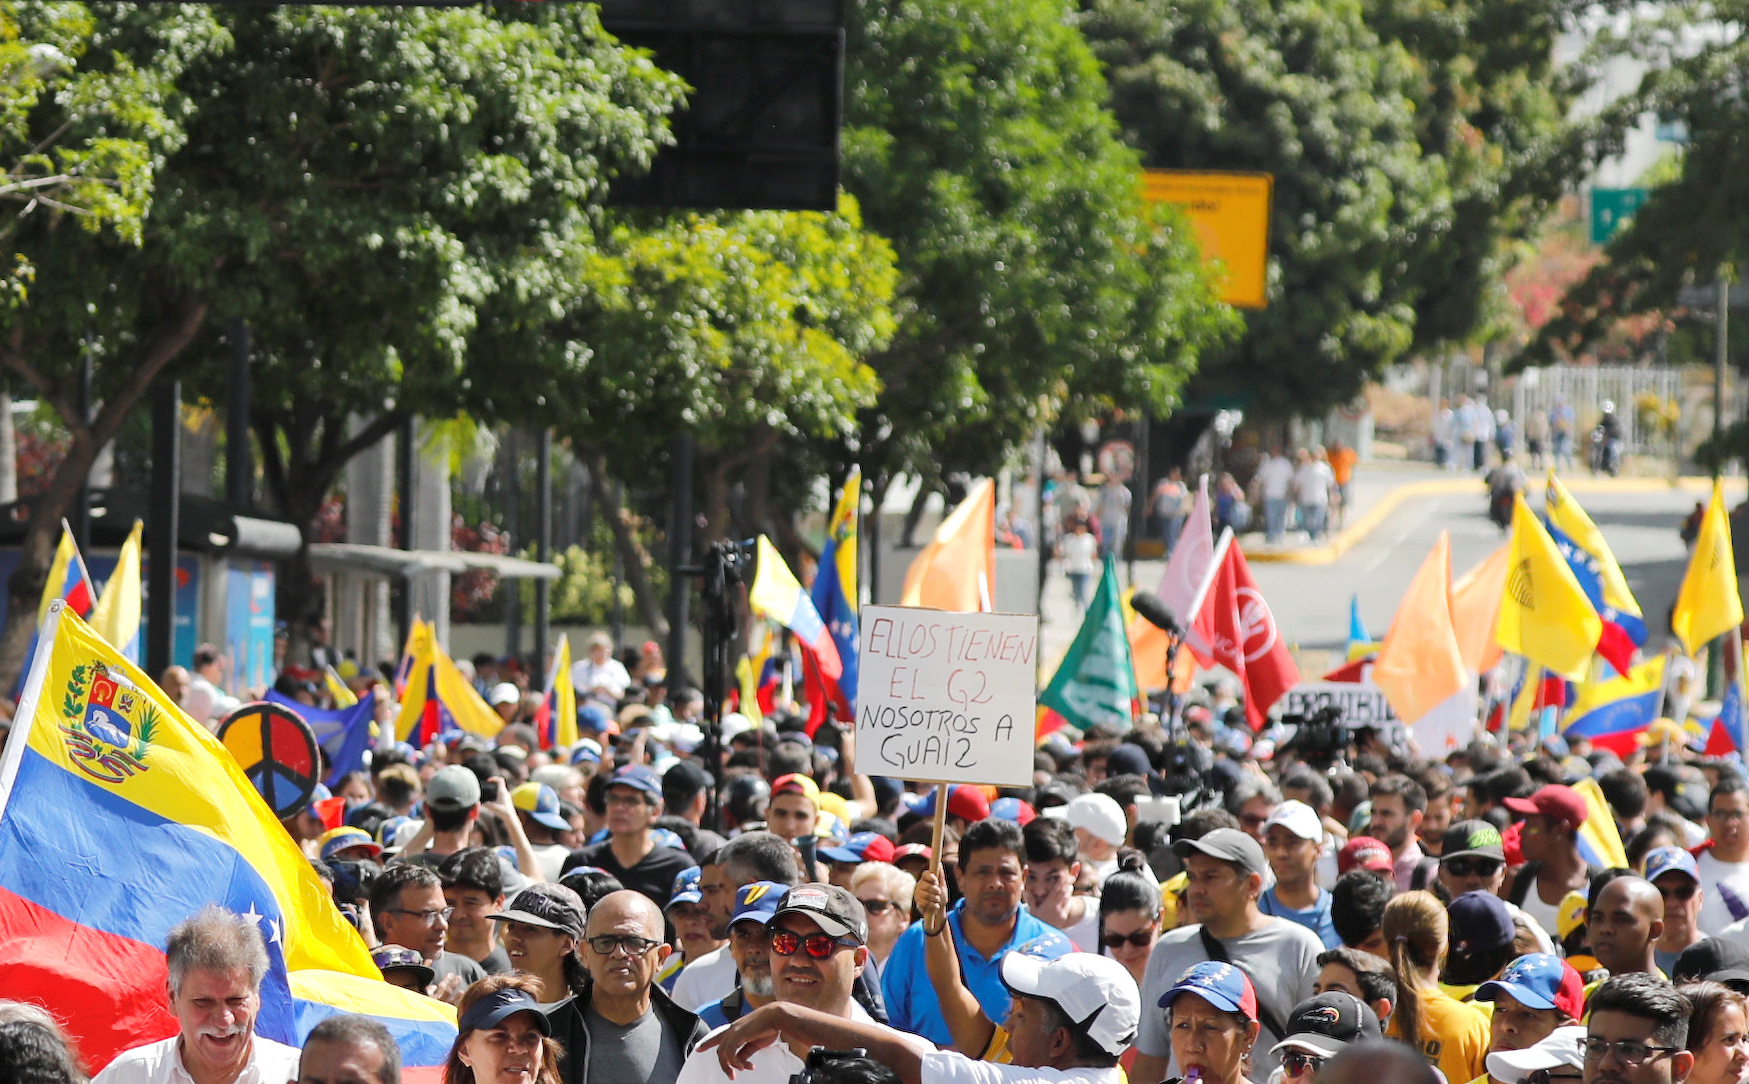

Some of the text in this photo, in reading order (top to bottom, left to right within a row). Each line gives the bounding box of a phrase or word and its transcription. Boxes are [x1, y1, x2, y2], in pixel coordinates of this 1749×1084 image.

[868, 618, 1035, 664] ELLOS TIENEN
[889, 666, 993, 711] EL G2
[860, 704, 1014, 741] NOSOTROS A
